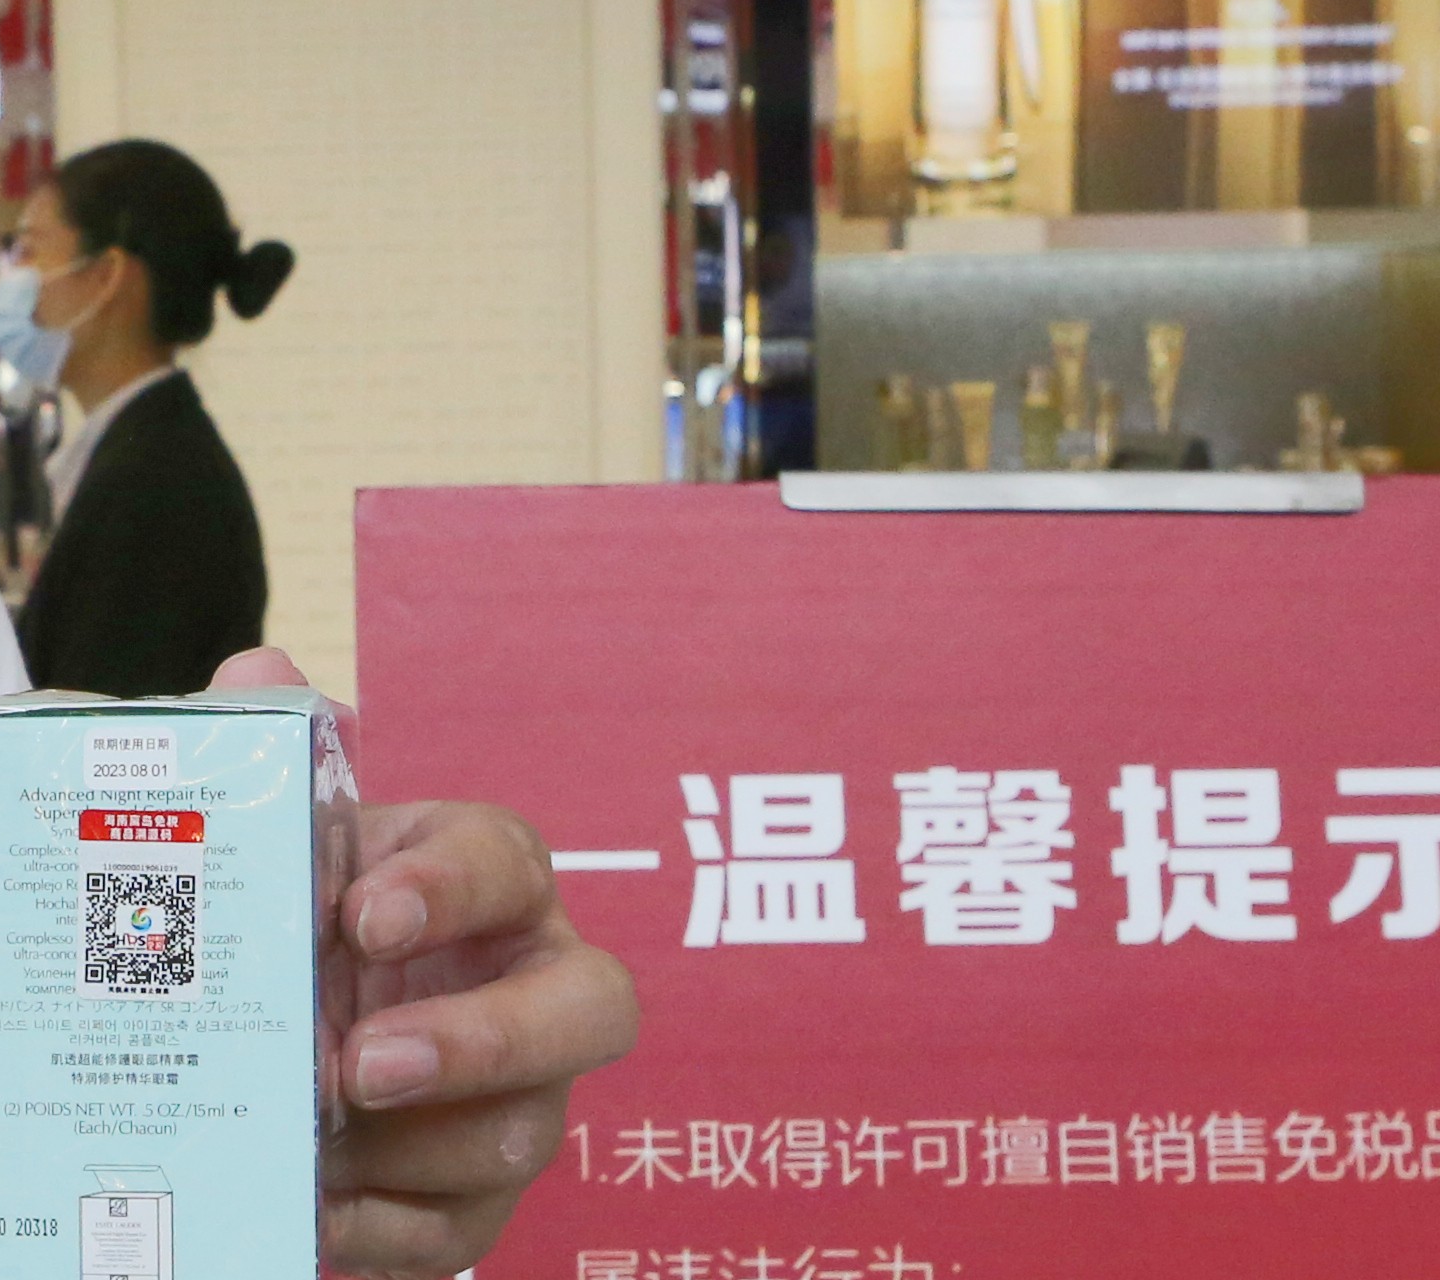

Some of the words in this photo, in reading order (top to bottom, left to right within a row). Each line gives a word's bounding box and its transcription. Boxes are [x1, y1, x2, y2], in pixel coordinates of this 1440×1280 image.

[93, 738, 170, 751] 限期使用日期
[93, 764, 127, 777] 2023
[130, 764, 149, 777] 08
[151, 764, 168, 777] 01
[19, 788, 95, 802] Advanced
[147, 790, 195, 806] Repair
[200, 789, 227, 806] Eye
[3, 1101, 21, 1118] (2)
[25, 1102, 72, 1117] POIDS
[76, 1102, 105, 1117] NET
[72, 1120, 178, 1136] (Each/Chacun)
[15, 1218, 59, 1237] 20318
